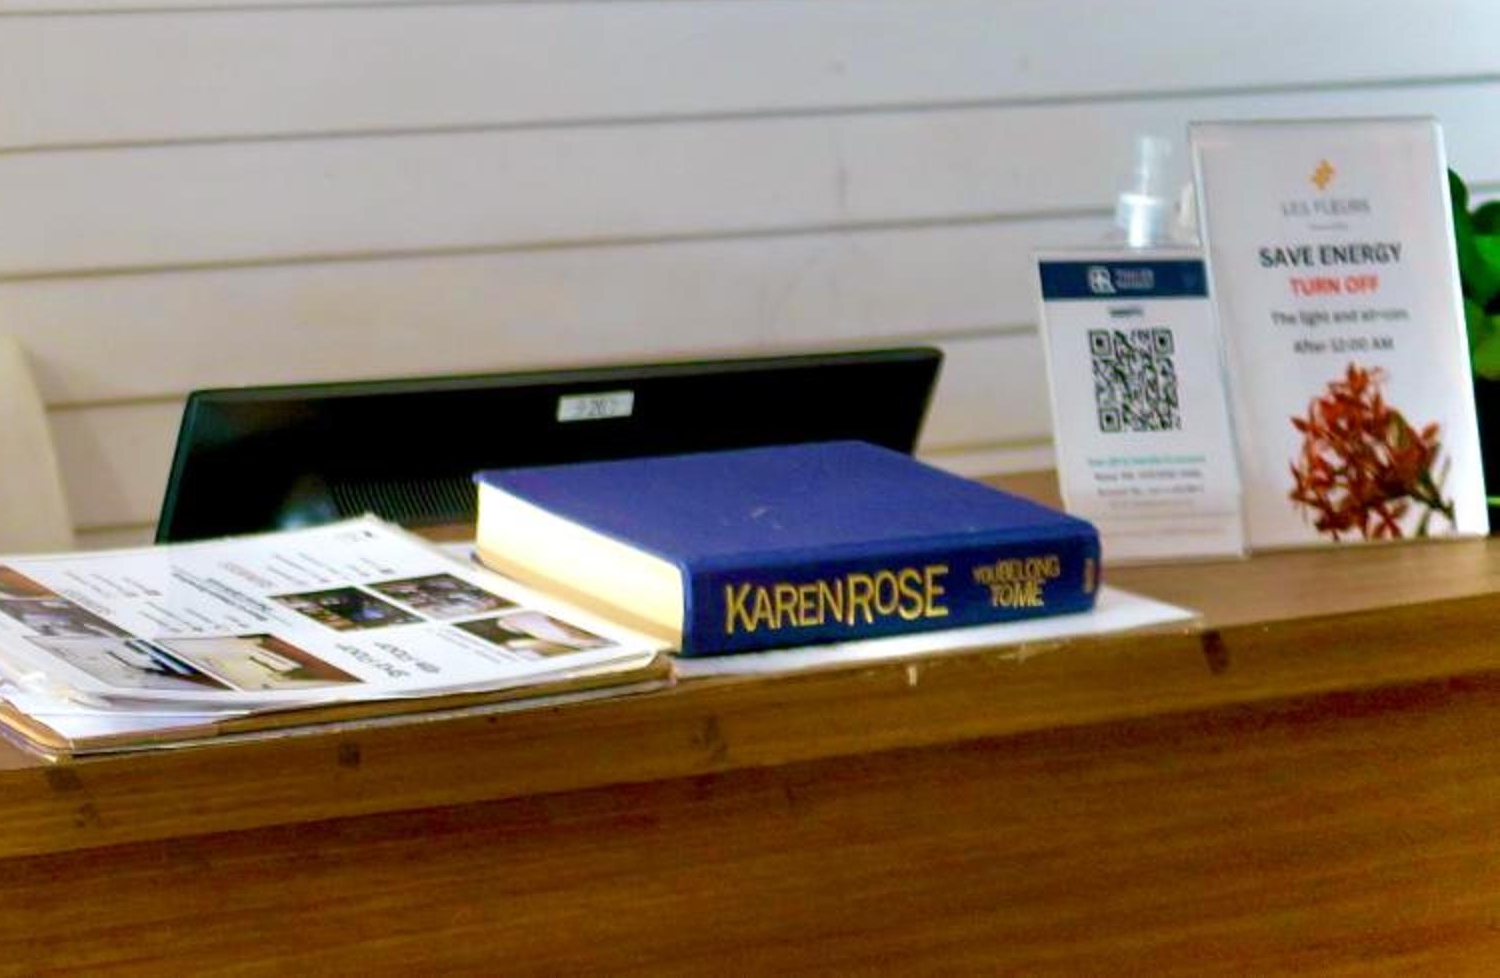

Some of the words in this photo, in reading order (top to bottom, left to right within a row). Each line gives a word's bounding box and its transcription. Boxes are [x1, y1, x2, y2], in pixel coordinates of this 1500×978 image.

[1258, 244, 1314, 268] SAVE
[1319, 241, 1402, 266] ENERGY
[1289, 275, 1341, 297] TURN
[1345, 274, 1380, 294] OFF
[1270, 310, 1297, 324] The
[1299, 309, 1330, 326] light
[1332, 308, 1357, 323] and
[1293, 339, 1326, 354] After
[1372, 336, 1395, 351] AM
[725, 578, 843, 635] KAREN
[847, 564, 949, 627] ROSE
